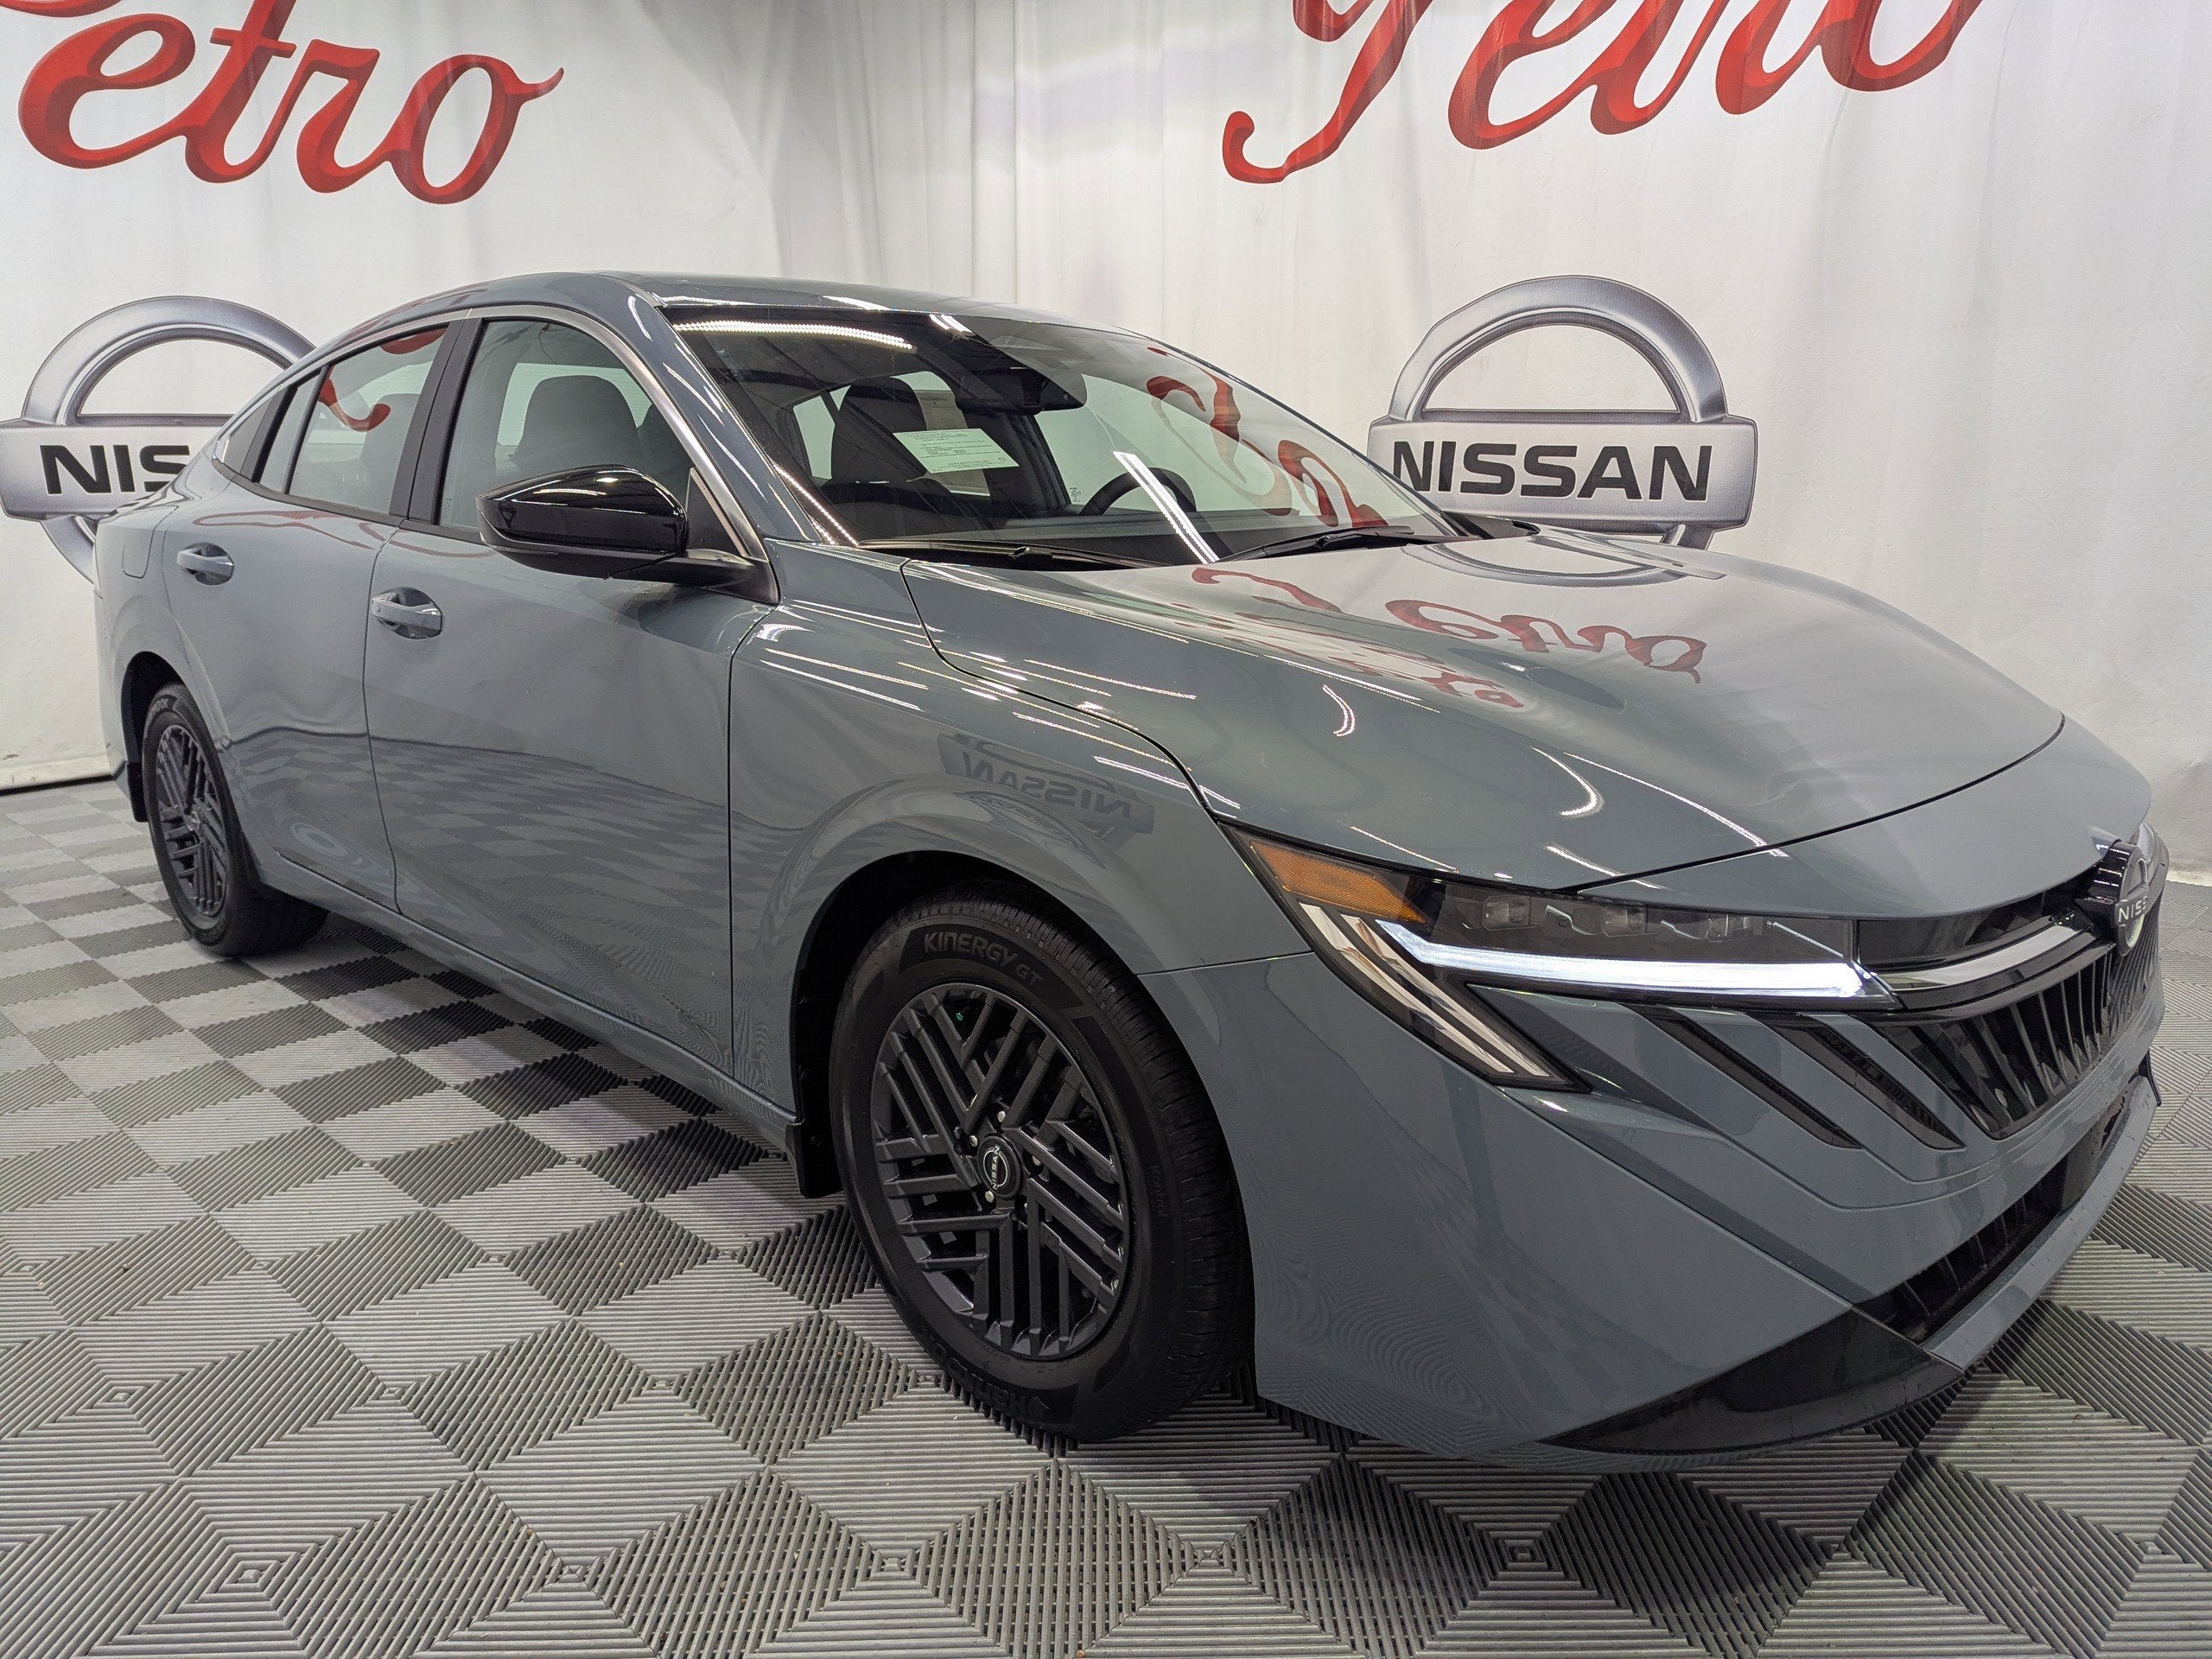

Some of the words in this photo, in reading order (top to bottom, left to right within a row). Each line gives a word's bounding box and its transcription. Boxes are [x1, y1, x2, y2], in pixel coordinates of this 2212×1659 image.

[0, 0, 563, 205] etro
[1393, 440, 1713, 502] NISSAN
[925, 931, 1019, 967] KINERGY
[991, 1145, 1001, 1191] NISSAN
